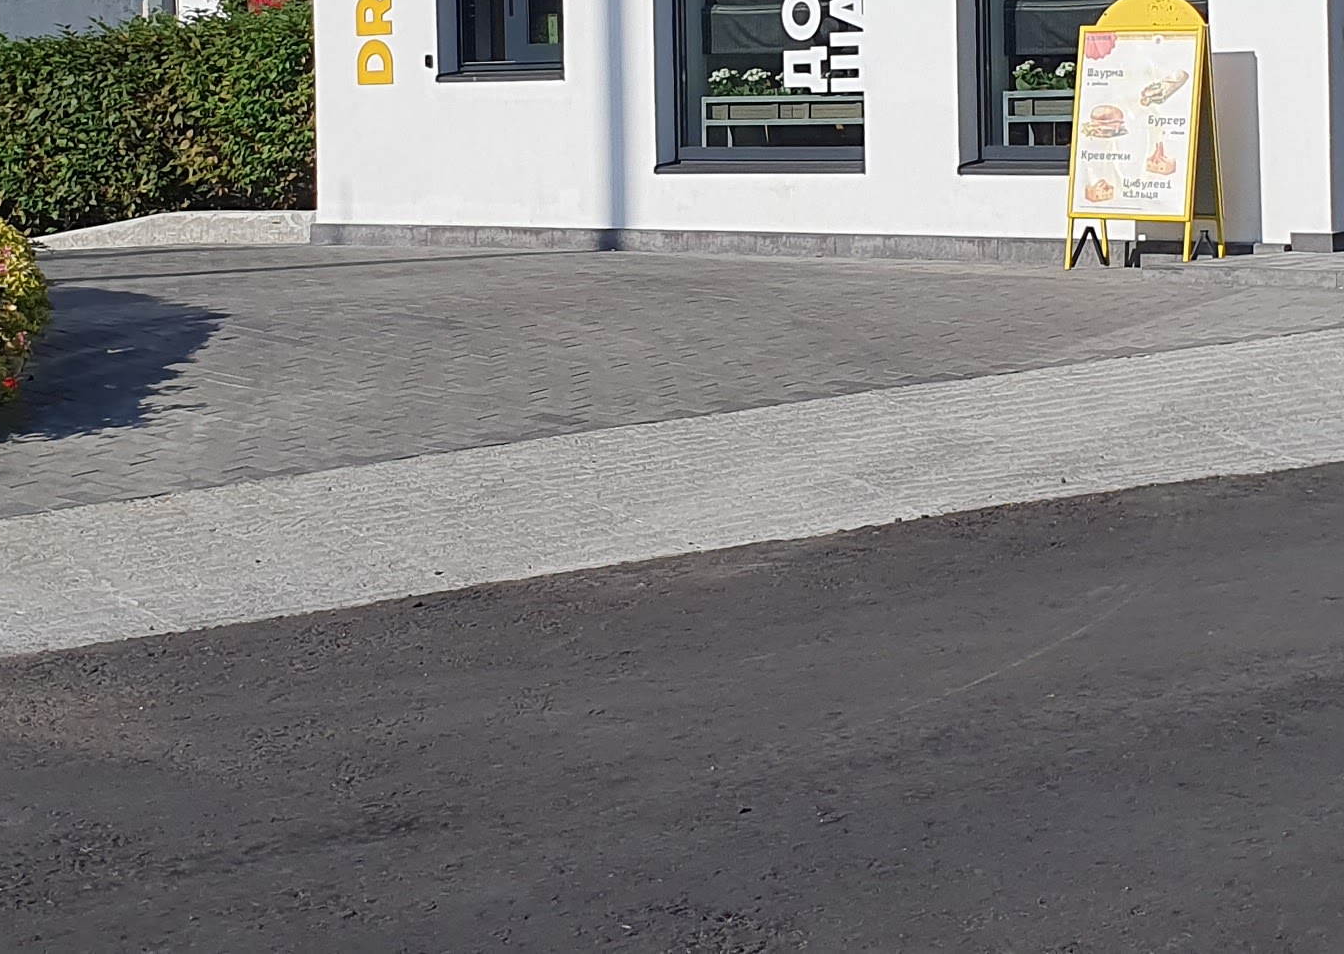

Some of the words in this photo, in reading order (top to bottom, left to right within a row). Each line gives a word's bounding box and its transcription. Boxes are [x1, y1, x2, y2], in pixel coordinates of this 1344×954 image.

[1087, 68, 1124, 80] Шаурма
[1147, 115, 1186, 127] Бургер
[1081, 150, 1131, 162] Креветки
[1123, 178, 1172, 189] Цибулеві
[1122, 190, 1159, 200] кільця
